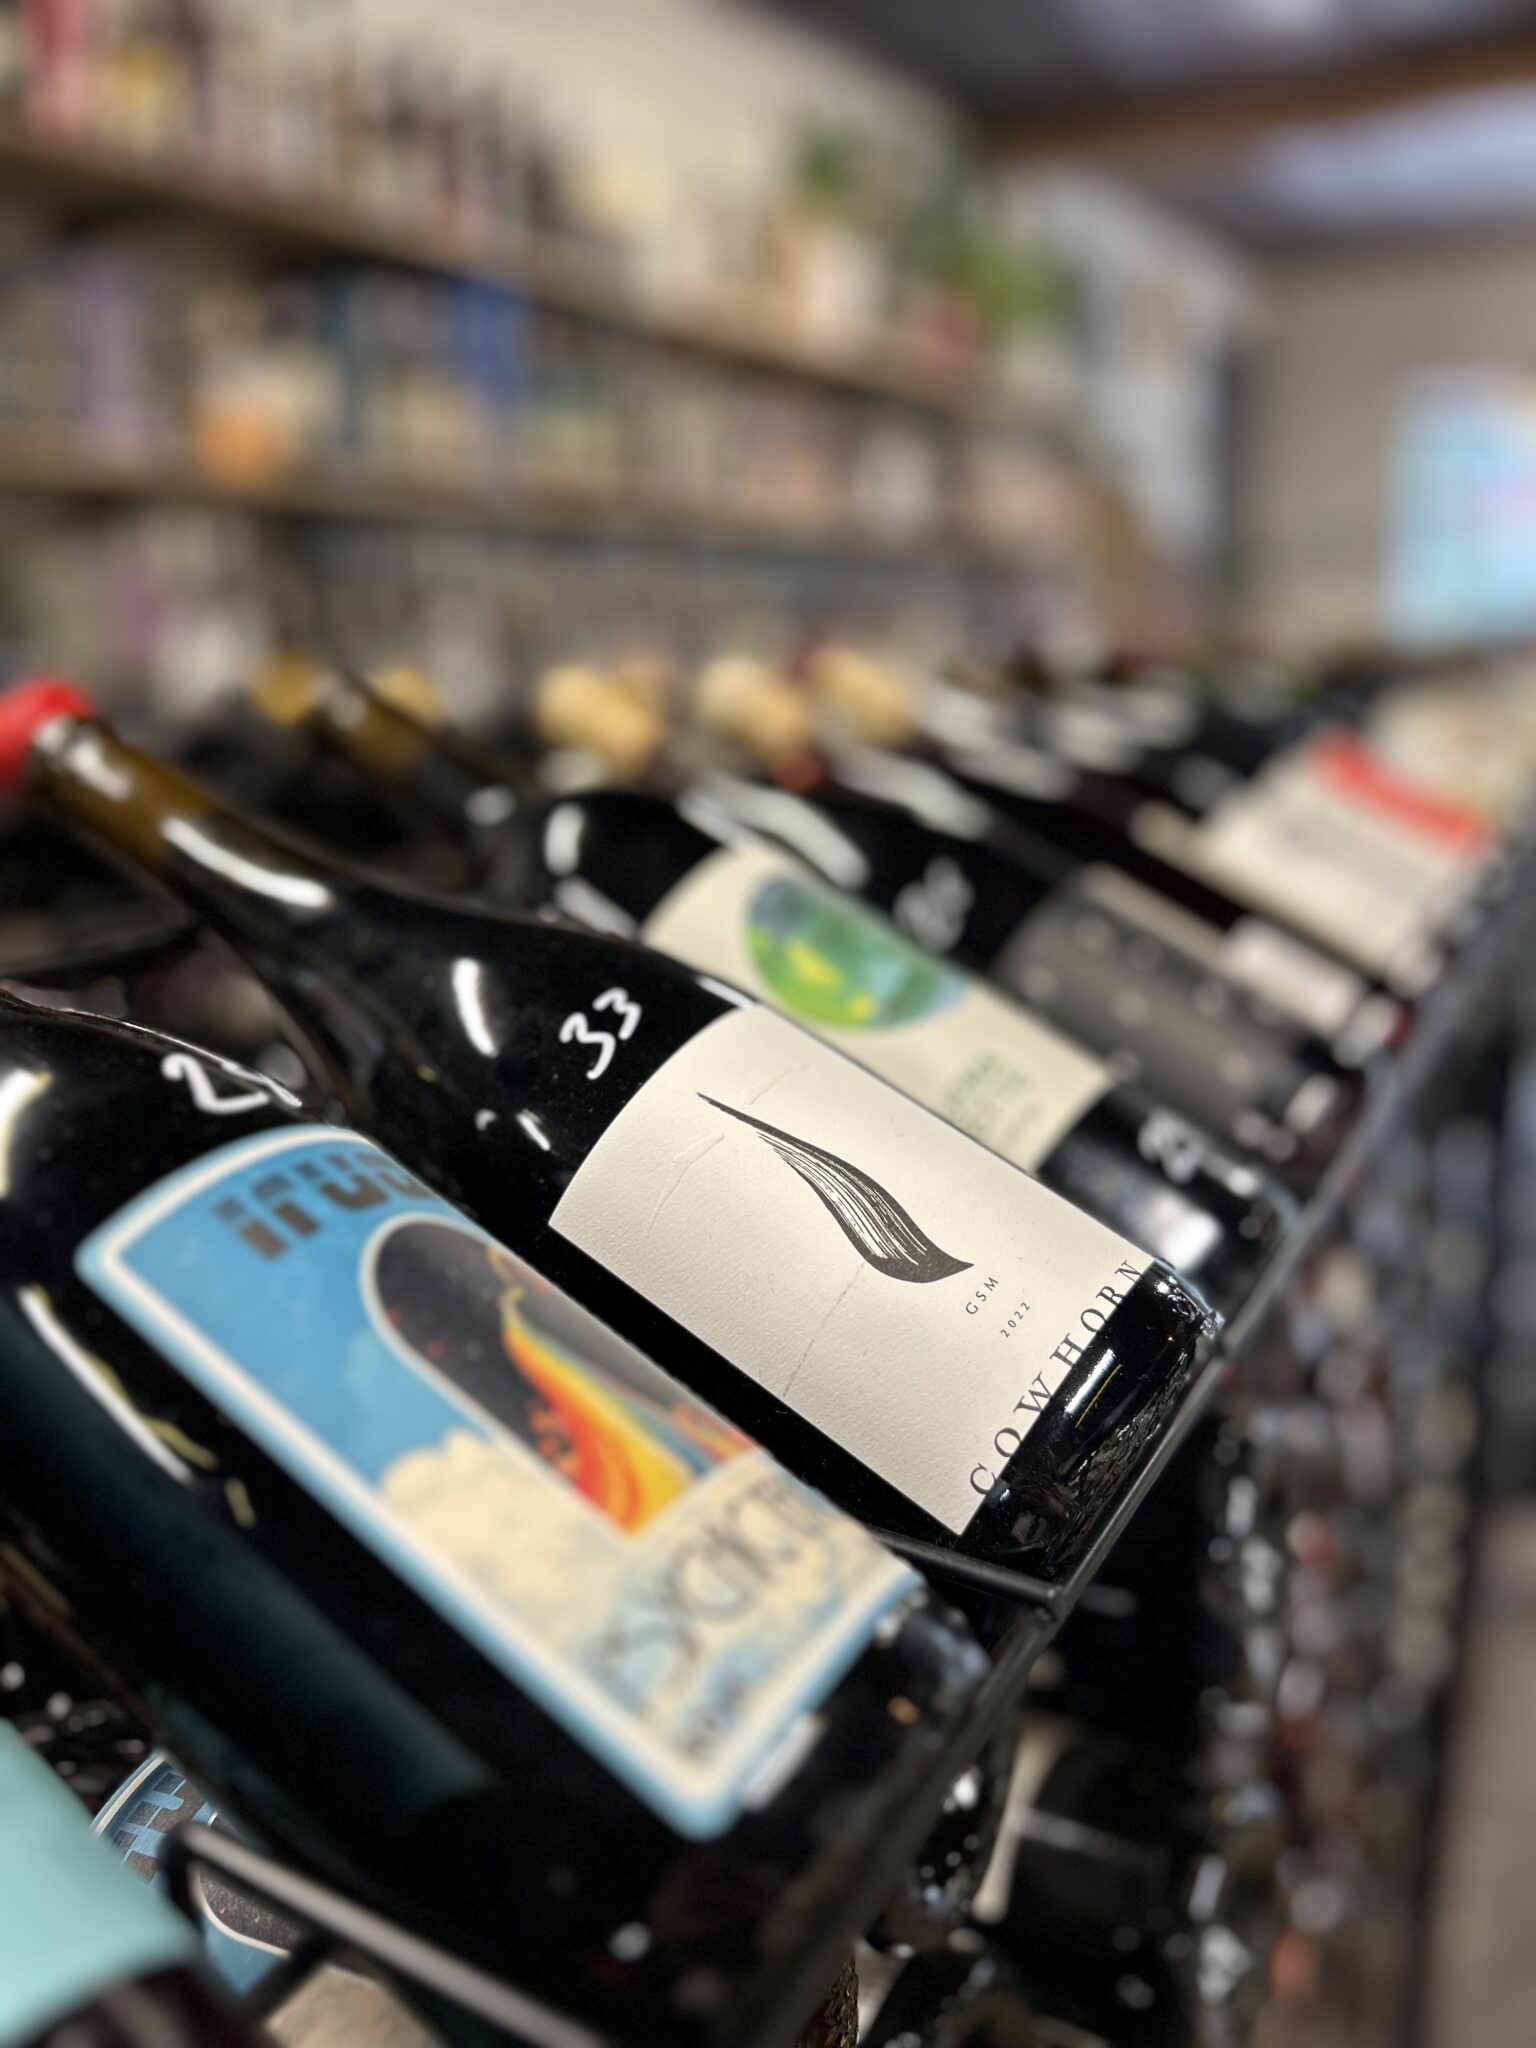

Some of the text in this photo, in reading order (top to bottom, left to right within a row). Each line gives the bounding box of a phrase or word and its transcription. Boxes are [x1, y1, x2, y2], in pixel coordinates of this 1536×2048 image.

[558, 987, 642, 1080] 33
[965, 1276, 999, 1315] GSM
[1000, 1301, 1031, 1339] 2022
[969, 1259, 1143, 1496] COWHORN
